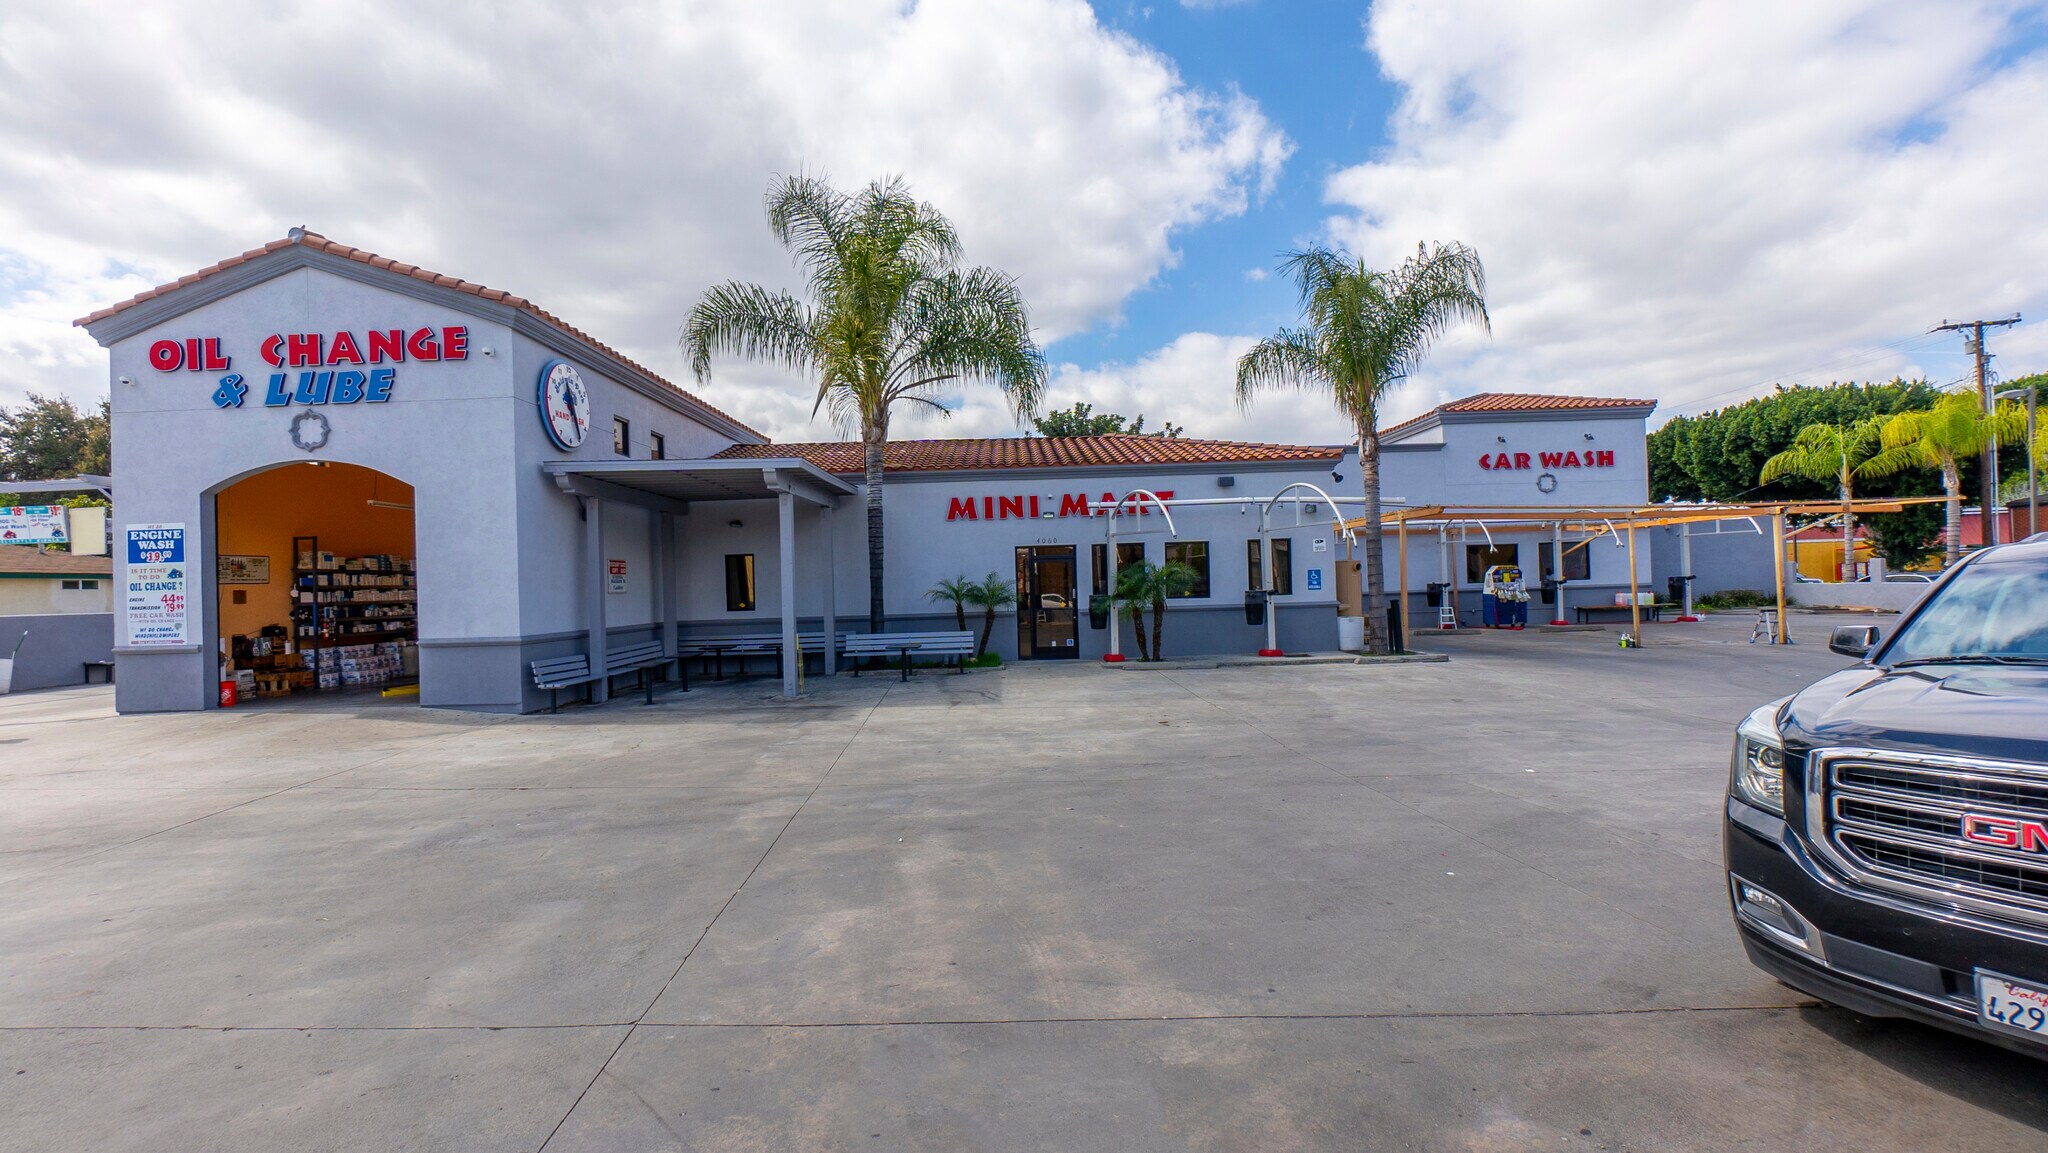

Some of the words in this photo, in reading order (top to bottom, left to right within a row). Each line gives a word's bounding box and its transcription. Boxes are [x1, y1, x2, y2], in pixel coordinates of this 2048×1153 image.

[149, 336, 232, 372] OIL
[260, 326, 468, 368] CHANGE
[212, 373, 249, 409] &
[264, 368, 395, 407] LUBE
[555, 410, 570, 421] HAND
[1478, 452, 1531, 471] CAR
[1538, 450, 1615, 470] WASH
[946, 495, 1040, 522] MINI
[1058, 490, 1175, 518] MART
[130, 530, 182, 540] ENGINE
[137, 540, 175, 549] WASH
[130, 583, 143, 591] OIL
[145, 582, 177, 591] CHANGE
